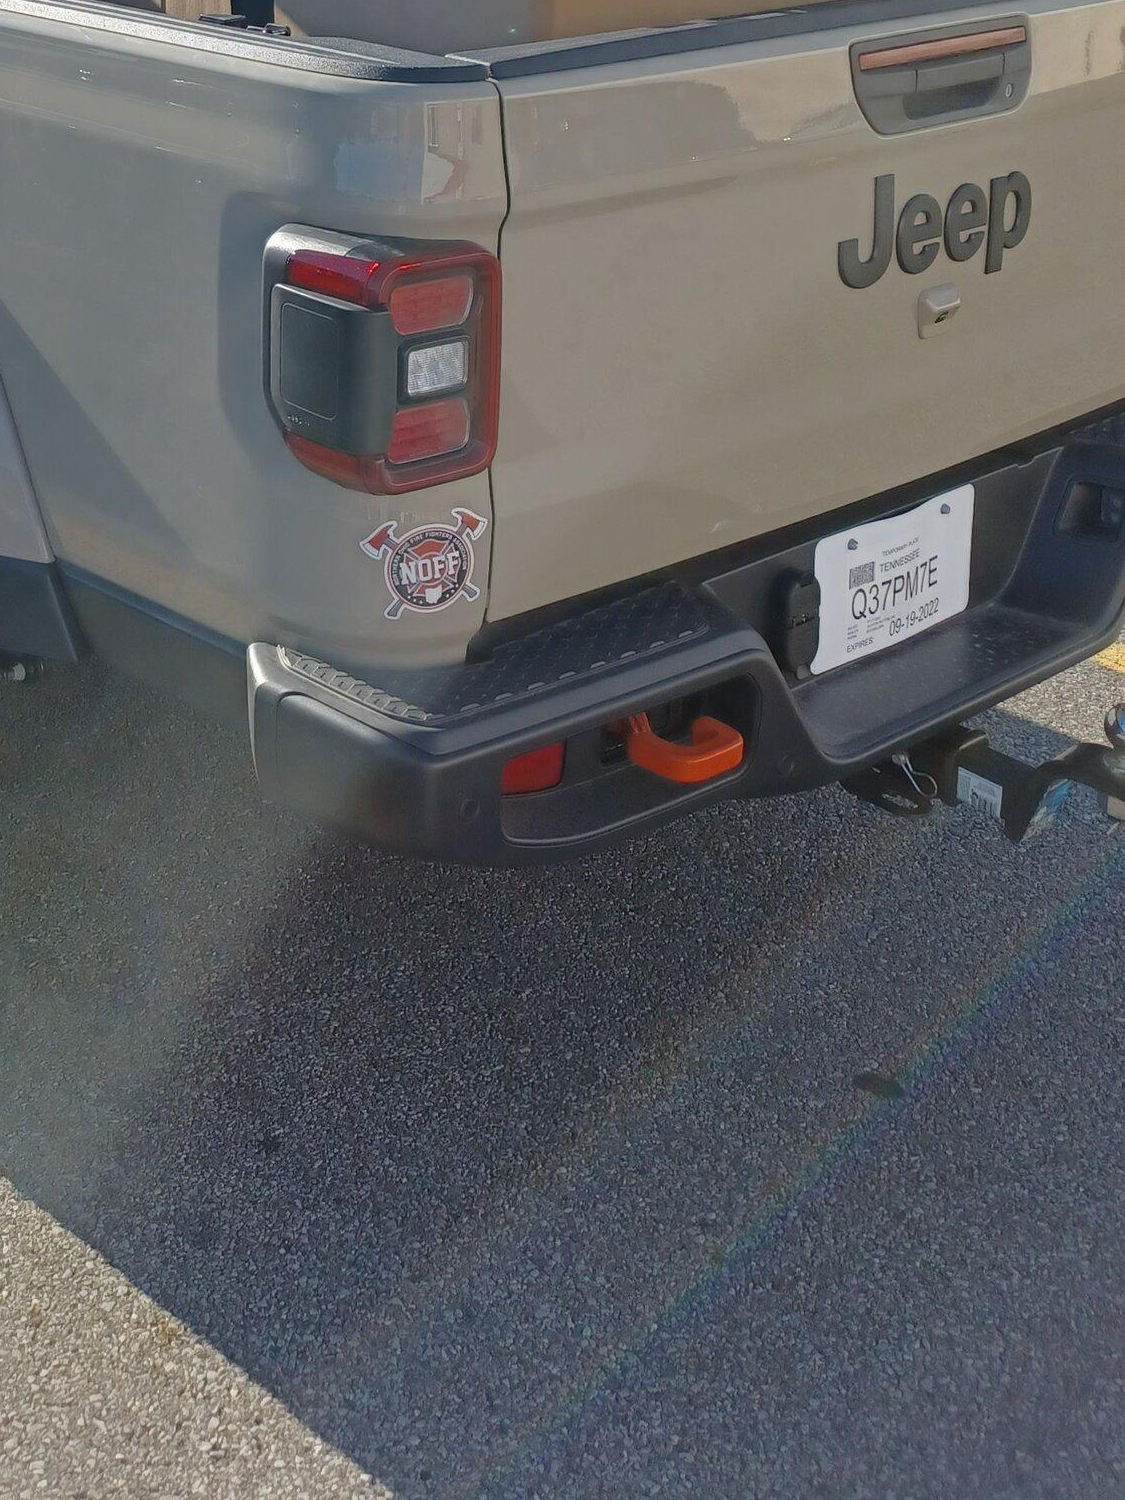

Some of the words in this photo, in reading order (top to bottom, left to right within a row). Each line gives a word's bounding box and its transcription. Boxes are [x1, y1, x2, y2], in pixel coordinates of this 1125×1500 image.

[838, 171, 1032, 289] Jeep
[399, 551, 460, 585] NOFF
[879, 548, 920, 572] TENNESSEE
[851, 555, 938, 620] Q37PM7E
[889, 597, 939, 636] 09-19-2022
[847, 636, 874, 653] EXPIRES:
